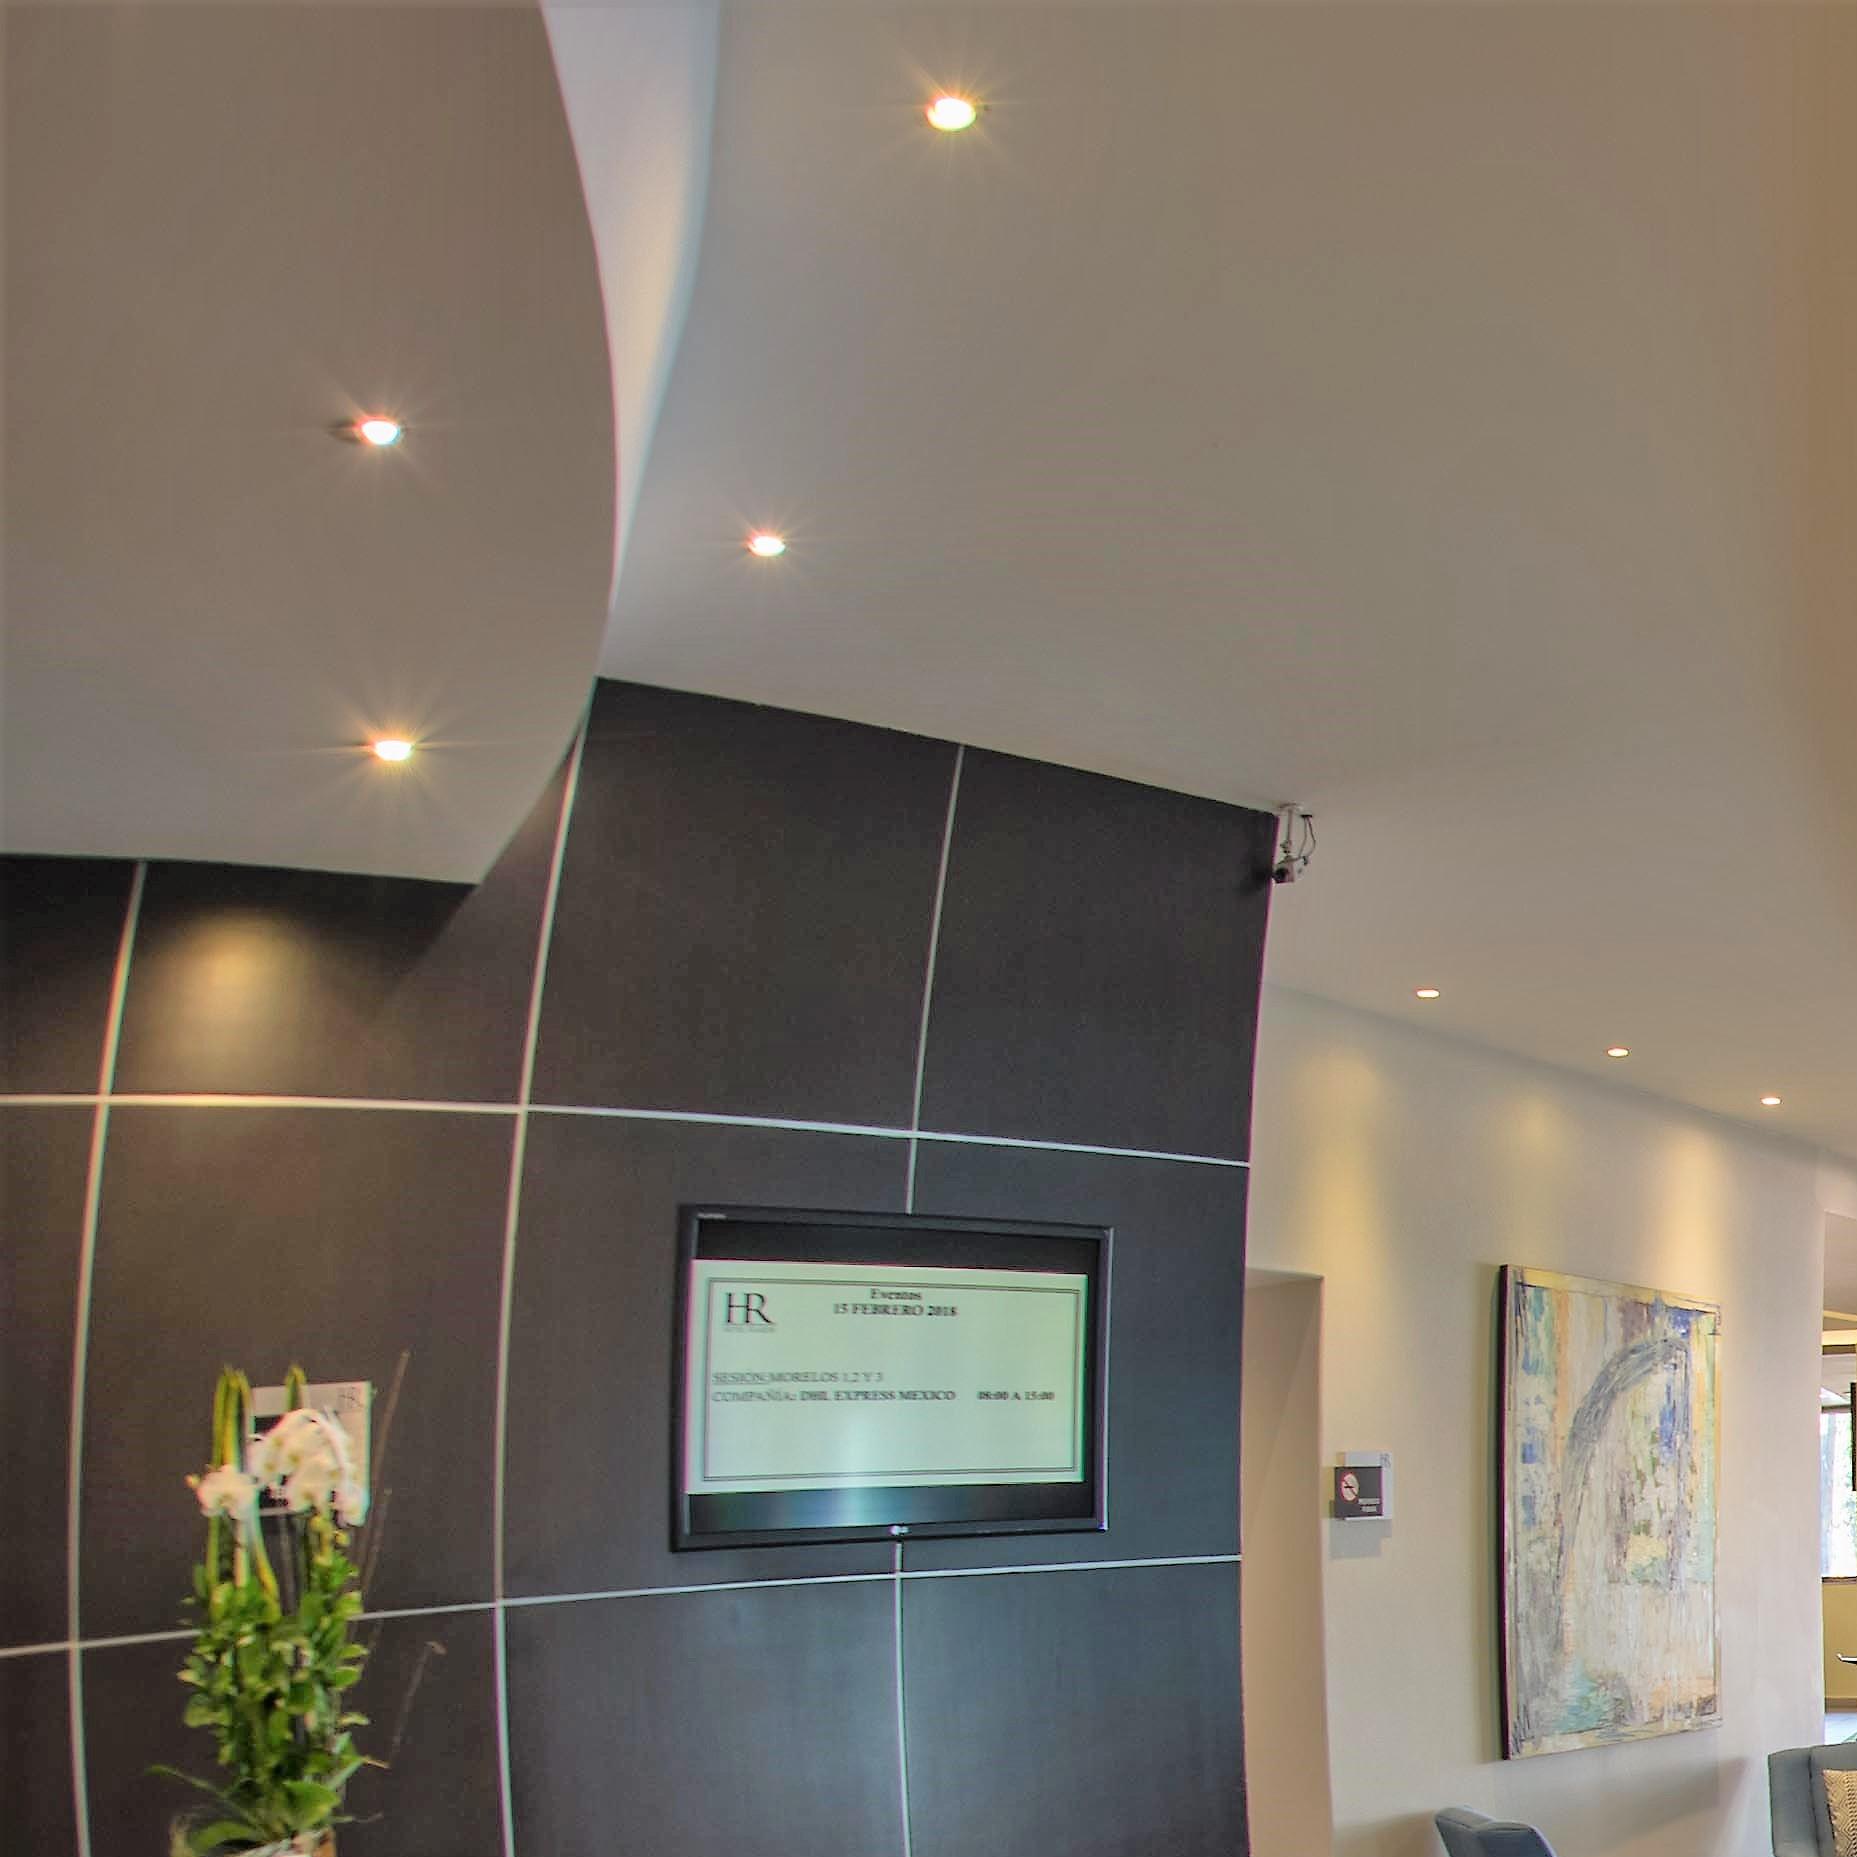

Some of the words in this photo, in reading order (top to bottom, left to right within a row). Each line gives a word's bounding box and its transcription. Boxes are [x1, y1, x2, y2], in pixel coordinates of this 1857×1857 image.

[725, 1292, 774, 1324] HR
[833, 1303, 848, 1314] 15
[852, 1303, 924, 1315] FEBRERO
[799, 1390, 828, 1401] DHL
[834, 1391, 896, 1401] EXPRESS
